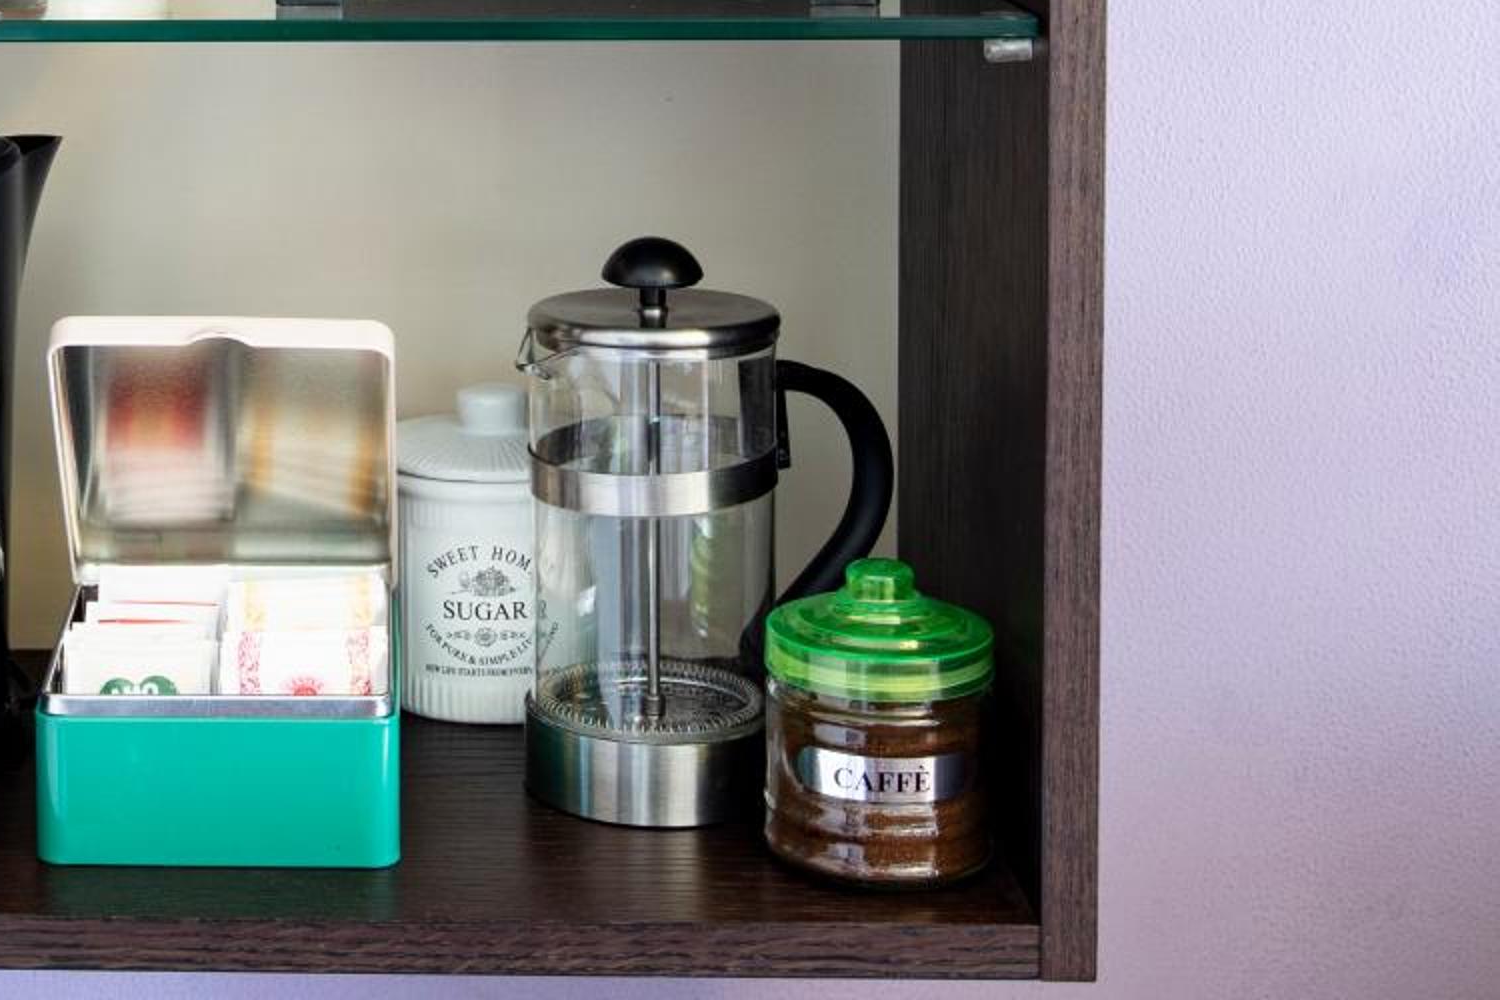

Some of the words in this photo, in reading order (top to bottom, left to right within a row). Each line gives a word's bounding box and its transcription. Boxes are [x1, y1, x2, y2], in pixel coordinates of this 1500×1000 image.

[427, 546, 479, 579] SWEET
[491, 546, 533, 575] HOM
[443, 599, 529, 621] SUGAR
[833, 765, 931, 793] CAFFÈ
